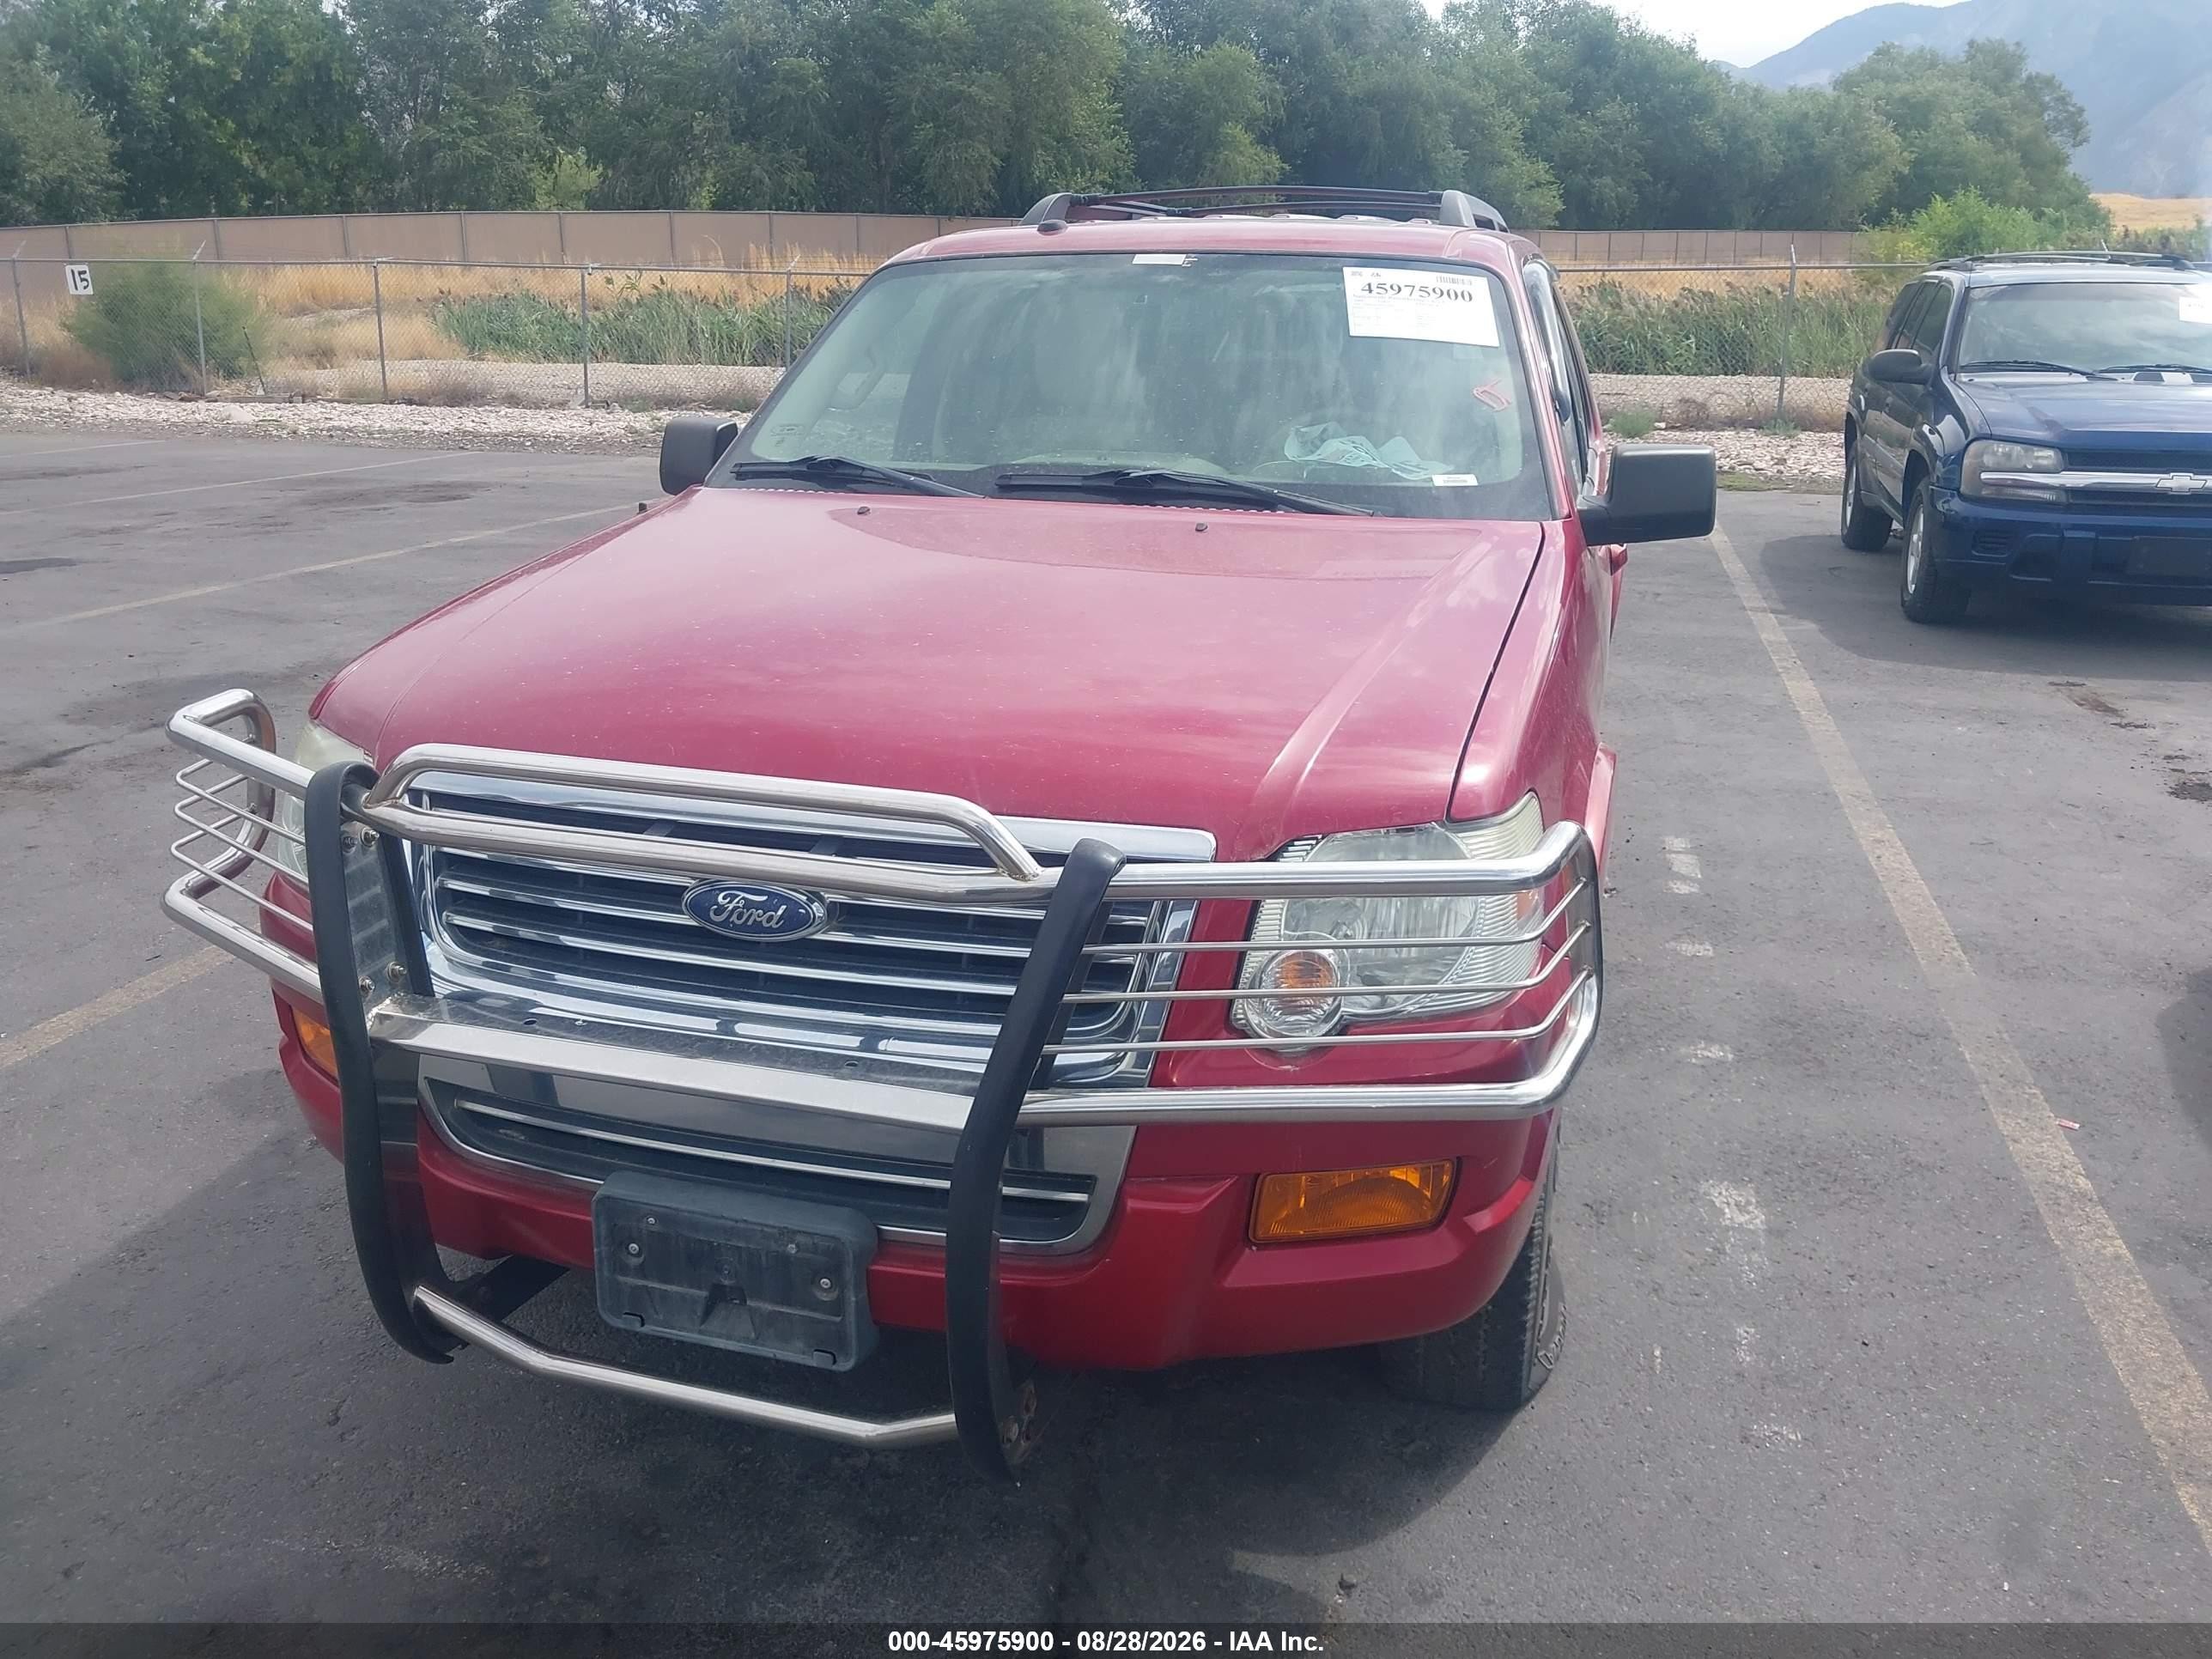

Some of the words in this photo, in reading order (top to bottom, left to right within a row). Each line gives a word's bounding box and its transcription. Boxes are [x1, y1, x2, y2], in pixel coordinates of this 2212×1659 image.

[70, 269, 89, 291] 15
[1361, 282, 1474, 303] 45975900
[709, 890, 787, 928] Ford
